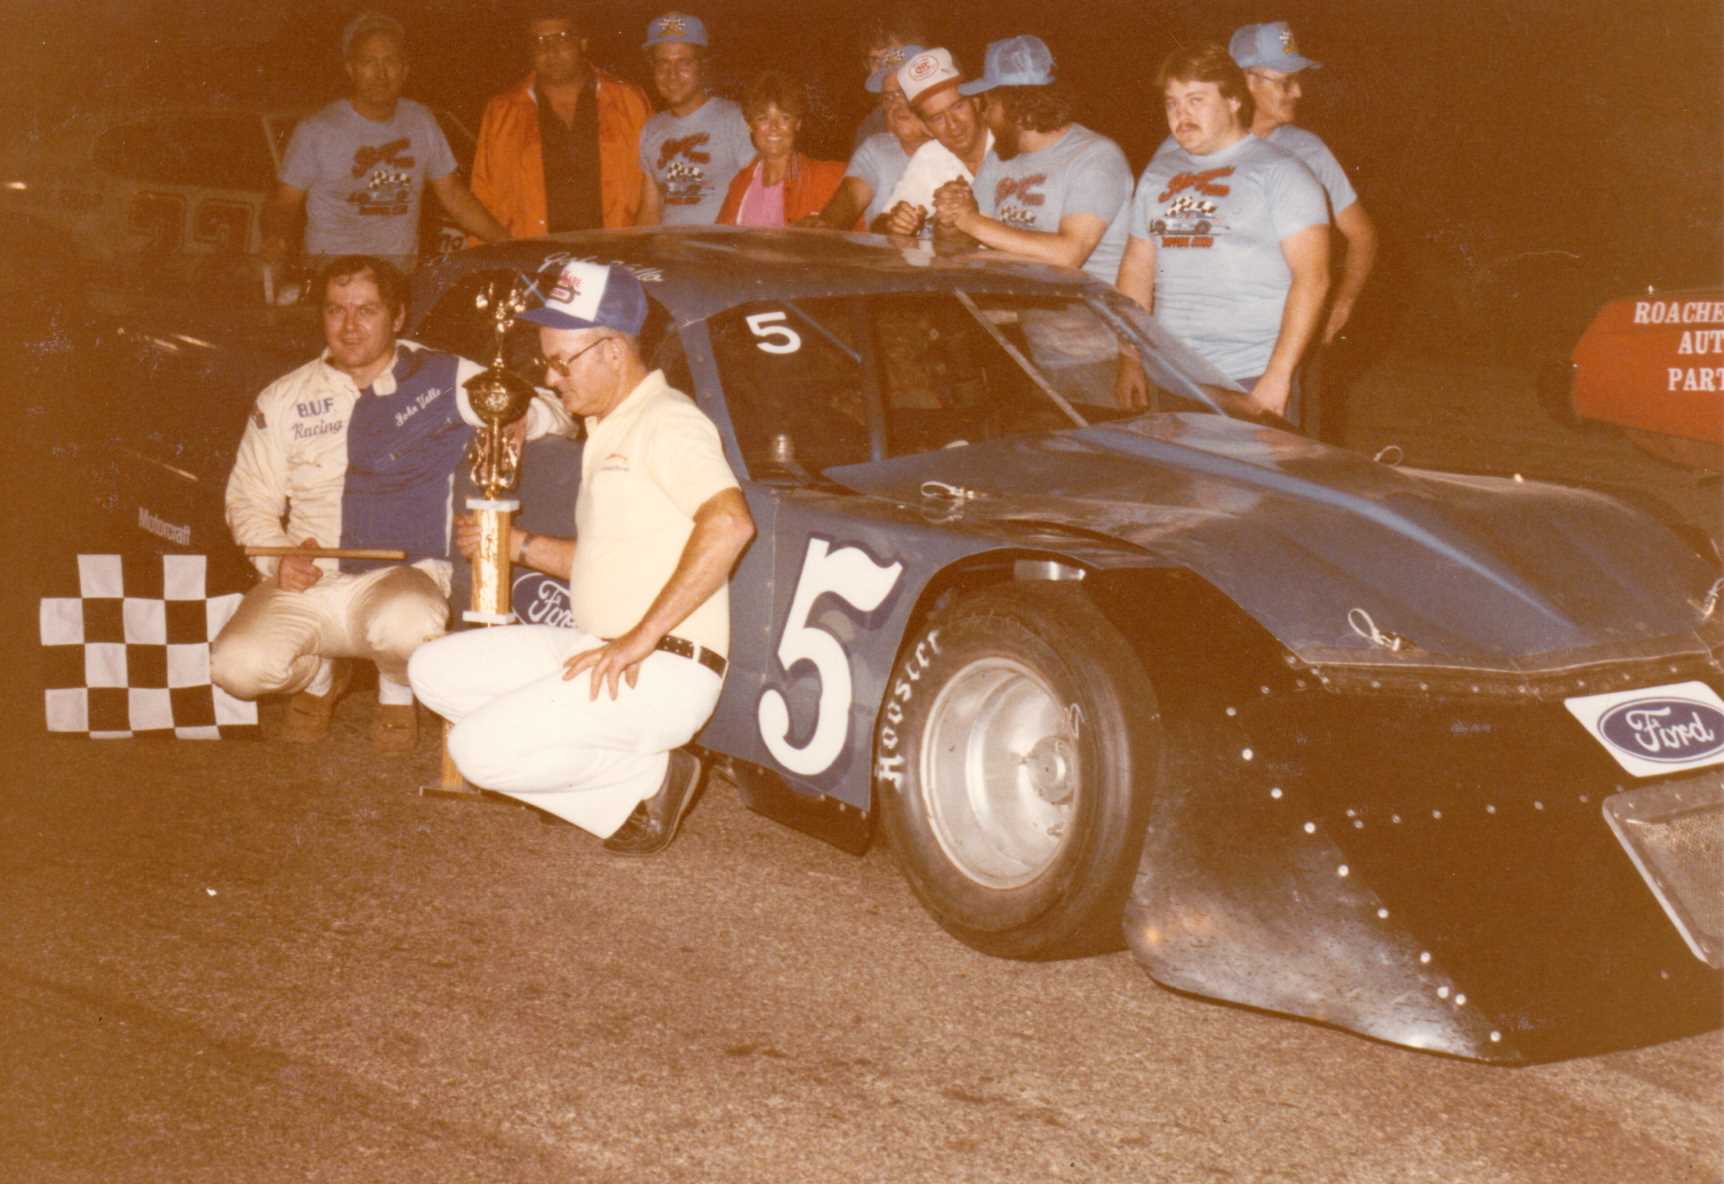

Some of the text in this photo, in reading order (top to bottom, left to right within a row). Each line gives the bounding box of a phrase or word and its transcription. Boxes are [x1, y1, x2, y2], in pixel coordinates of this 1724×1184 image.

[746, 312, 801, 354] 5
[1633, 302, 1724, 324] ROACHE
[1678, 330, 1724, 355] AUT
[291, 419, 343, 440] Racing
[528, 579, 576, 628] For
[758, 538, 903, 776] 5
[1626, 707, 1714, 752] Ford
